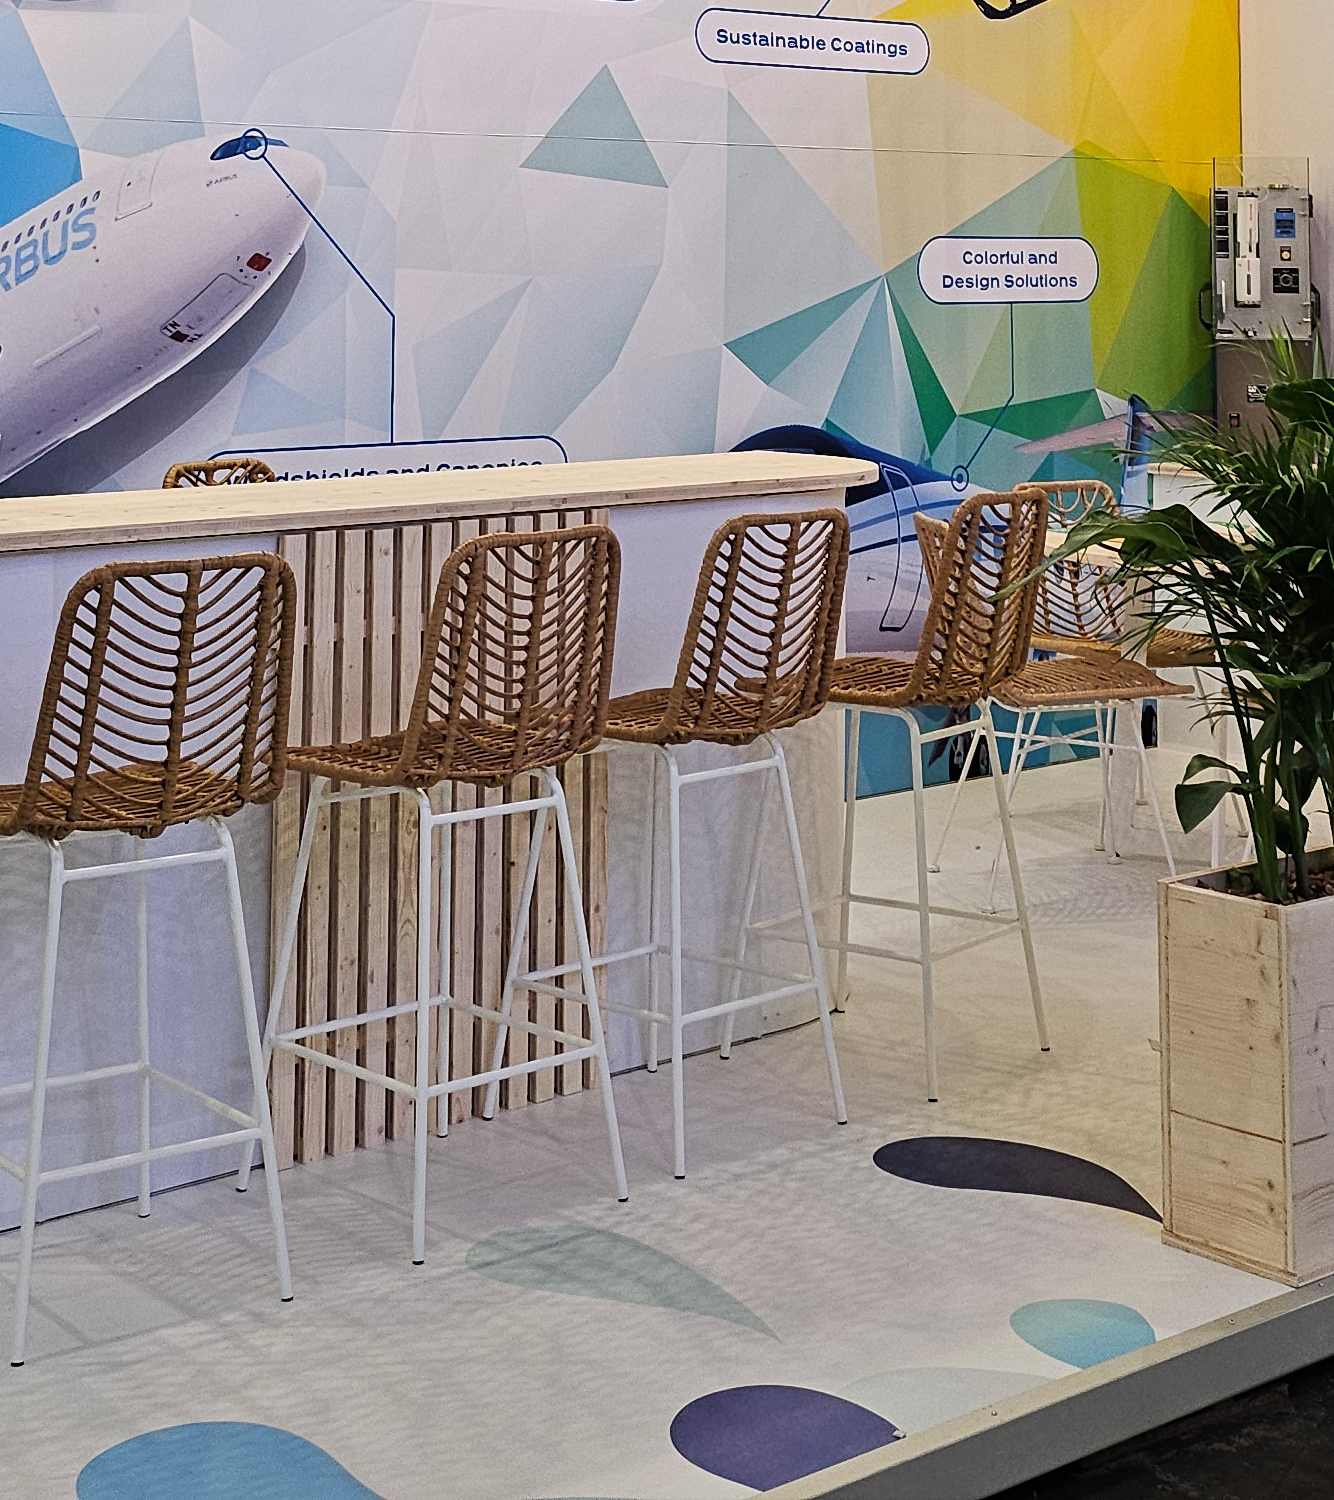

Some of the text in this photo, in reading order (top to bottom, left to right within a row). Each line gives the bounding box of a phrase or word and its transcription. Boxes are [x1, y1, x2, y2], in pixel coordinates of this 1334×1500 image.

[716, 27, 909, 58] Sustainable Coatings
[962, 250, 1058, 265] Colorful and
[942, 273, 1078, 291] Design Solutions
